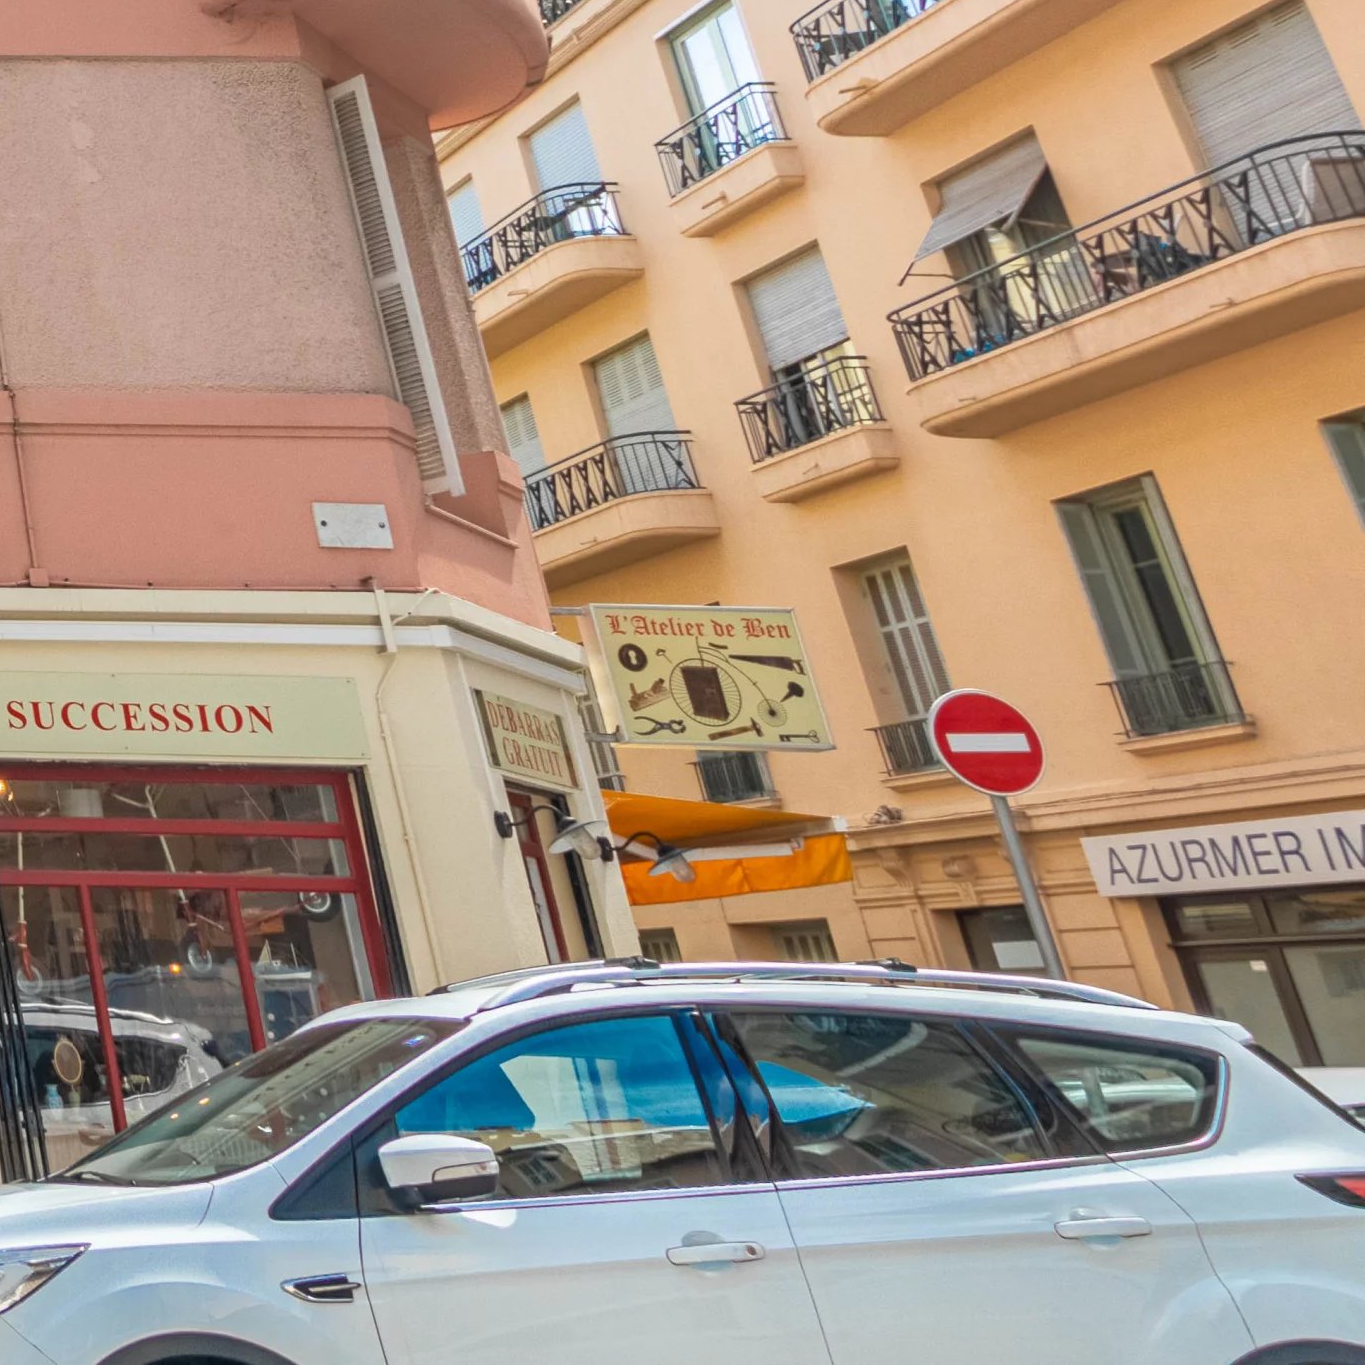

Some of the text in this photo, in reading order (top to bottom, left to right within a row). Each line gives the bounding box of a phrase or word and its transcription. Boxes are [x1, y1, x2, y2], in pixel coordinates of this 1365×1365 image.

[604, 614, 792, 641] L'Atelier de Ben
[5, 699, 274, 735] SUCCESSION
[502, 736, 563, 778] GRATUIT
[1107, 829, 1313, 886] AZURMER
